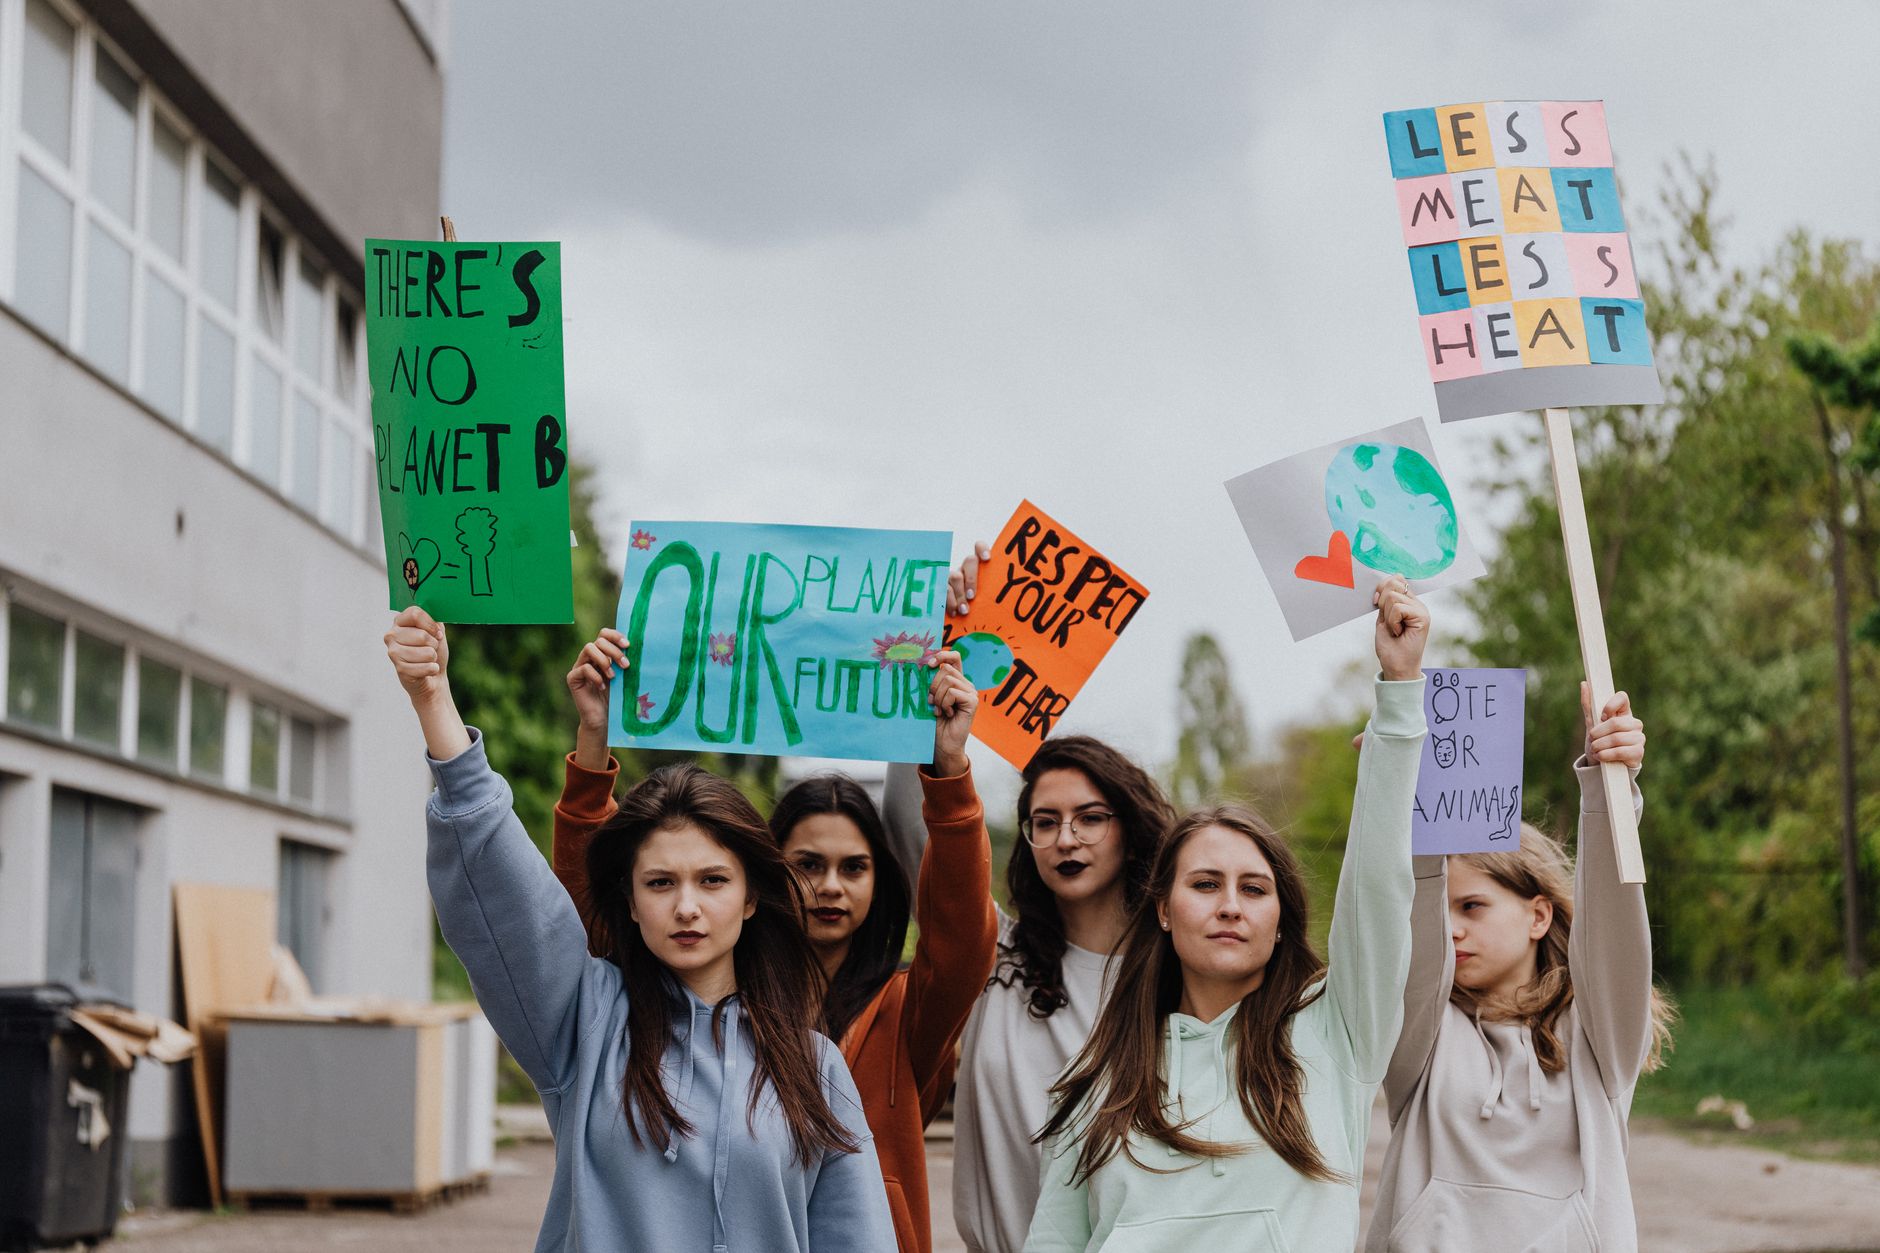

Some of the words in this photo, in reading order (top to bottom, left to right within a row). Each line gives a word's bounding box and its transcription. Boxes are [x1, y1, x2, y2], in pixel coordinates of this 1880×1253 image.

[1405, 109, 1582, 159] LESS
[1411, 173, 1593, 229] MEAT
[373, 244, 547, 328] THERE'S
[1431, 239, 1619, 297] LESS
[1431, 304, 1625, 365] HEAT
[389, 344, 478, 405] NO
[375, 422, 511, 496] PLANET
[533, 413, 567, 489] B
[994, 562, 1086, 649] YOUR
[621, 540, 803, 747] OUR
[798, 553, 951, 618] PLANET
[1431, 672, 1497, 724] OTE
[1431, 729, 1480, 770] OR
